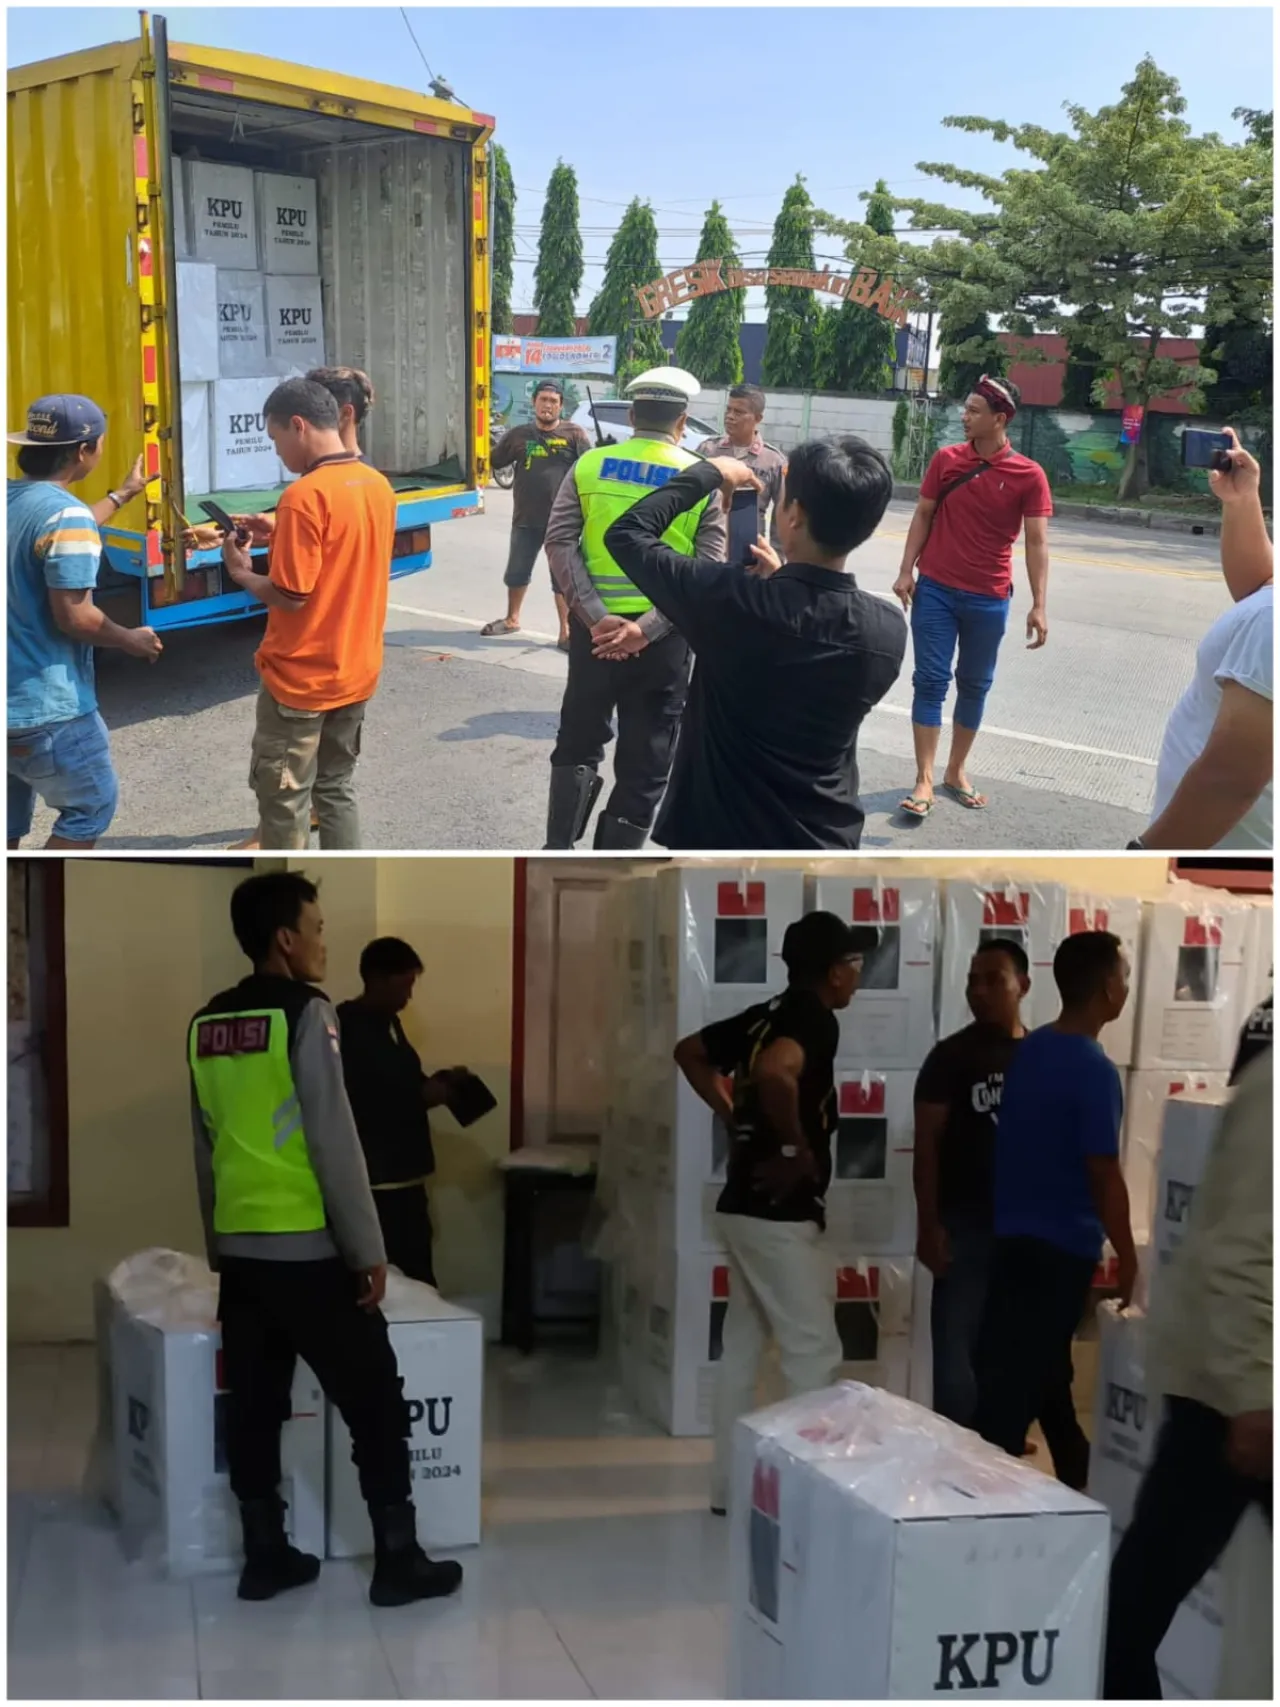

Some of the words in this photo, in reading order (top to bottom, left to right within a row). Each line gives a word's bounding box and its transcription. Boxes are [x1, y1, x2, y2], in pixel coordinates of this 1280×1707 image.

[207, 197, 242, 219] KPU
[276, 207, 307, 227] KPU
[637, 257, 728, 318] GRESIK
[218, 303, 251, 322] KPU
[279, 308, 312, 326] KPU
[229, 413, 266, 434] KPU
[226, 447, 252, 456] TAHUN
[254, 445, 273, 453] 2024
[235, 437, 263, 445] PEMILU
[420, 1465, 461, 1479] 2024
[934, 1629, 1059, 1690] KPU
